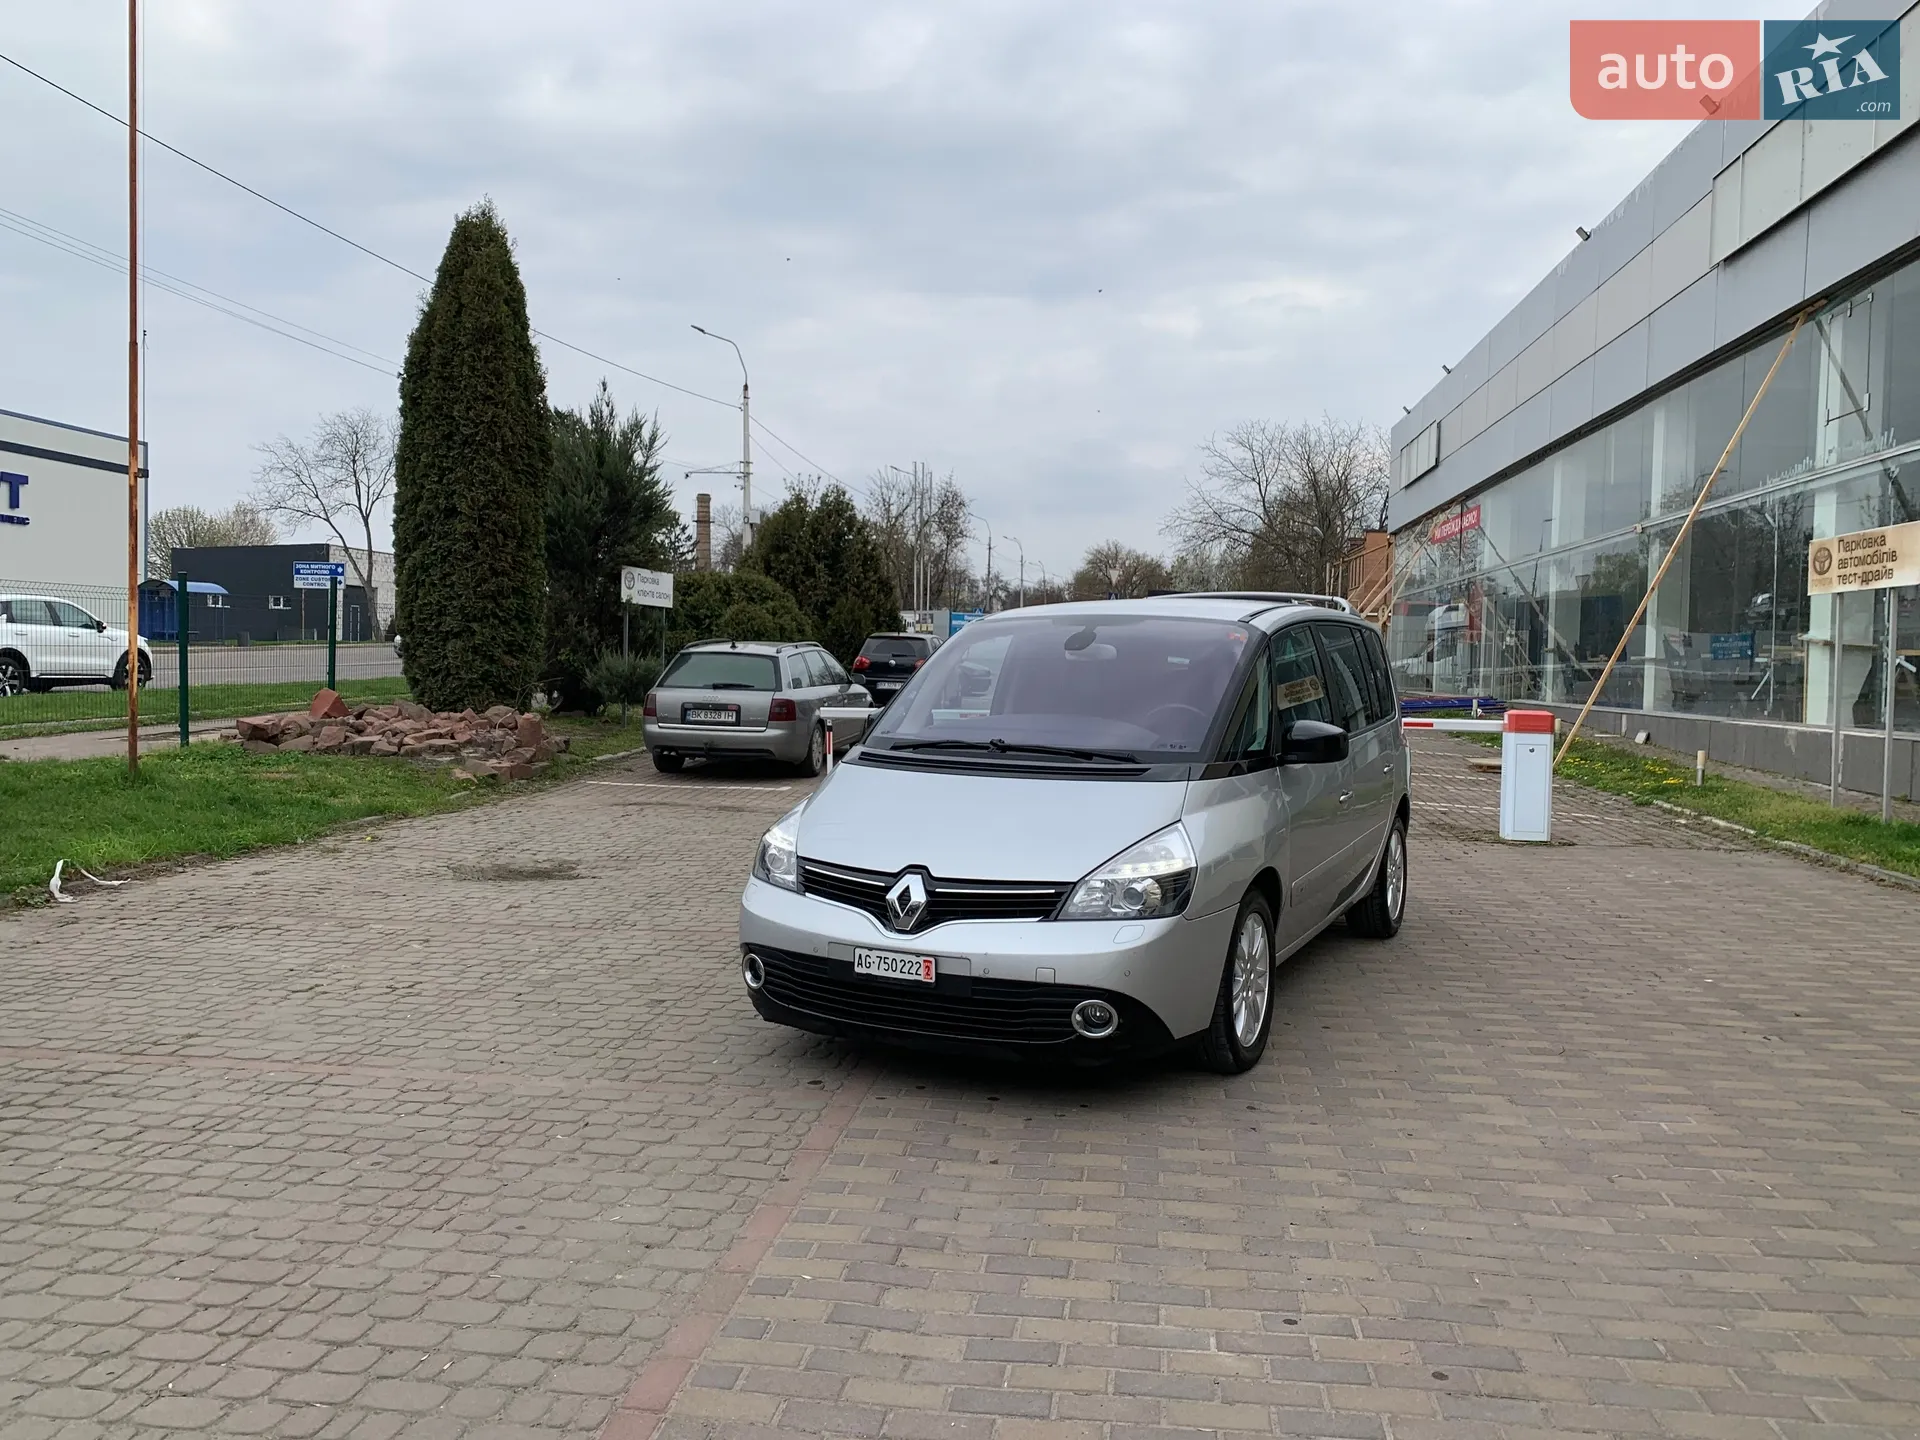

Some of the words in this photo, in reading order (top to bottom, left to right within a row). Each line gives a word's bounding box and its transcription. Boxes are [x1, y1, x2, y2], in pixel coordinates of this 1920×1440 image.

[1838, 534, 1886, 554] Парковка
[1837, 548, 1898, 570] автомобілів
[637, 573, 660, 586] Парковка
[1837, 565, 1894, 586] тест-драйв
[691, 710, 702, 719] BK
[703, 710, 722, 720] 8328
[724, 710, 734, 720] IH
